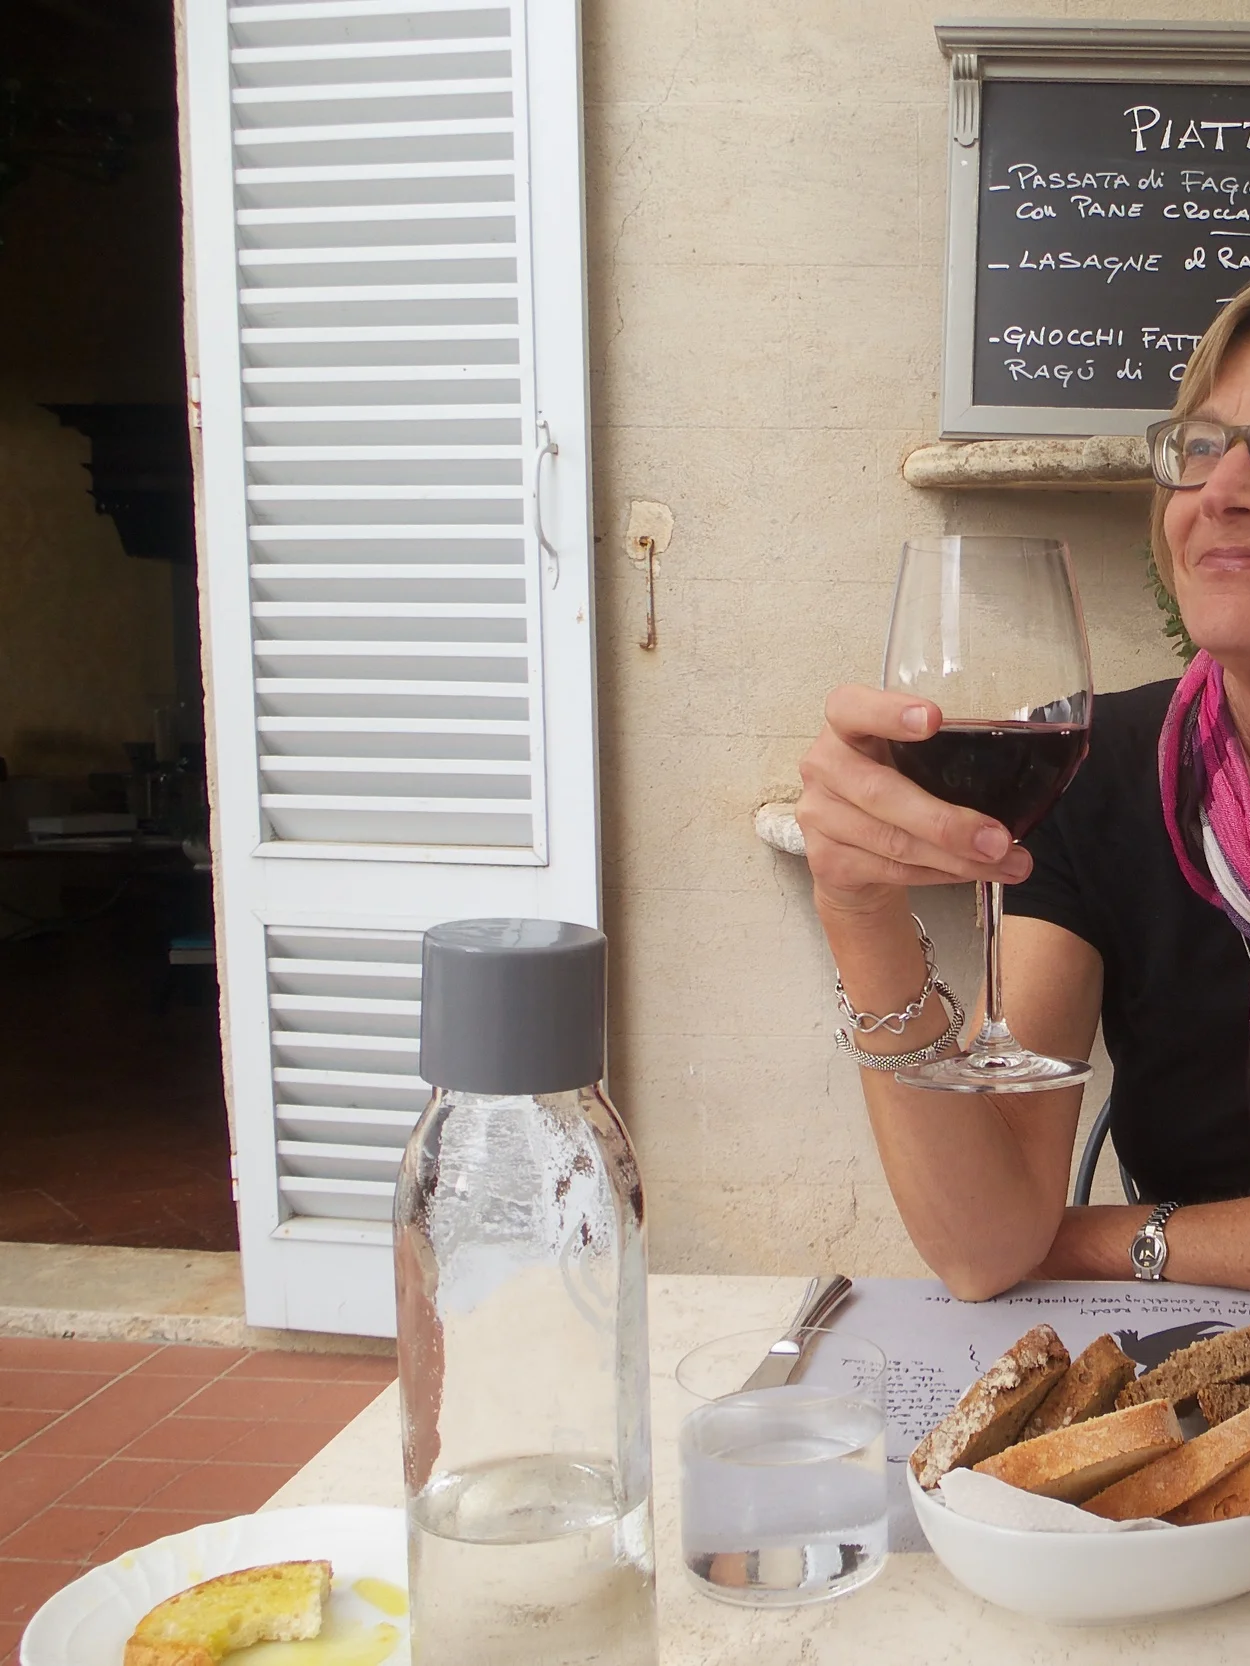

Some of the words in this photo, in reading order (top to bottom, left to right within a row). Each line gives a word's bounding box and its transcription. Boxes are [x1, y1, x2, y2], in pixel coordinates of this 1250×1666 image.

[1008, 163, 1130, 190] PASSATA
[1138, 168, 1164, 190] di
[1070, 195, 1143, 219] PANE
[1019, 250, 1162, 284] LASAGNE
[1003, 326, 1123, 353] GNOCCHI
[1141, 327, 1202, 352] FATT
[1116, 358, 1142, 381] di
[1231, 1300, 1250, 1308] to
